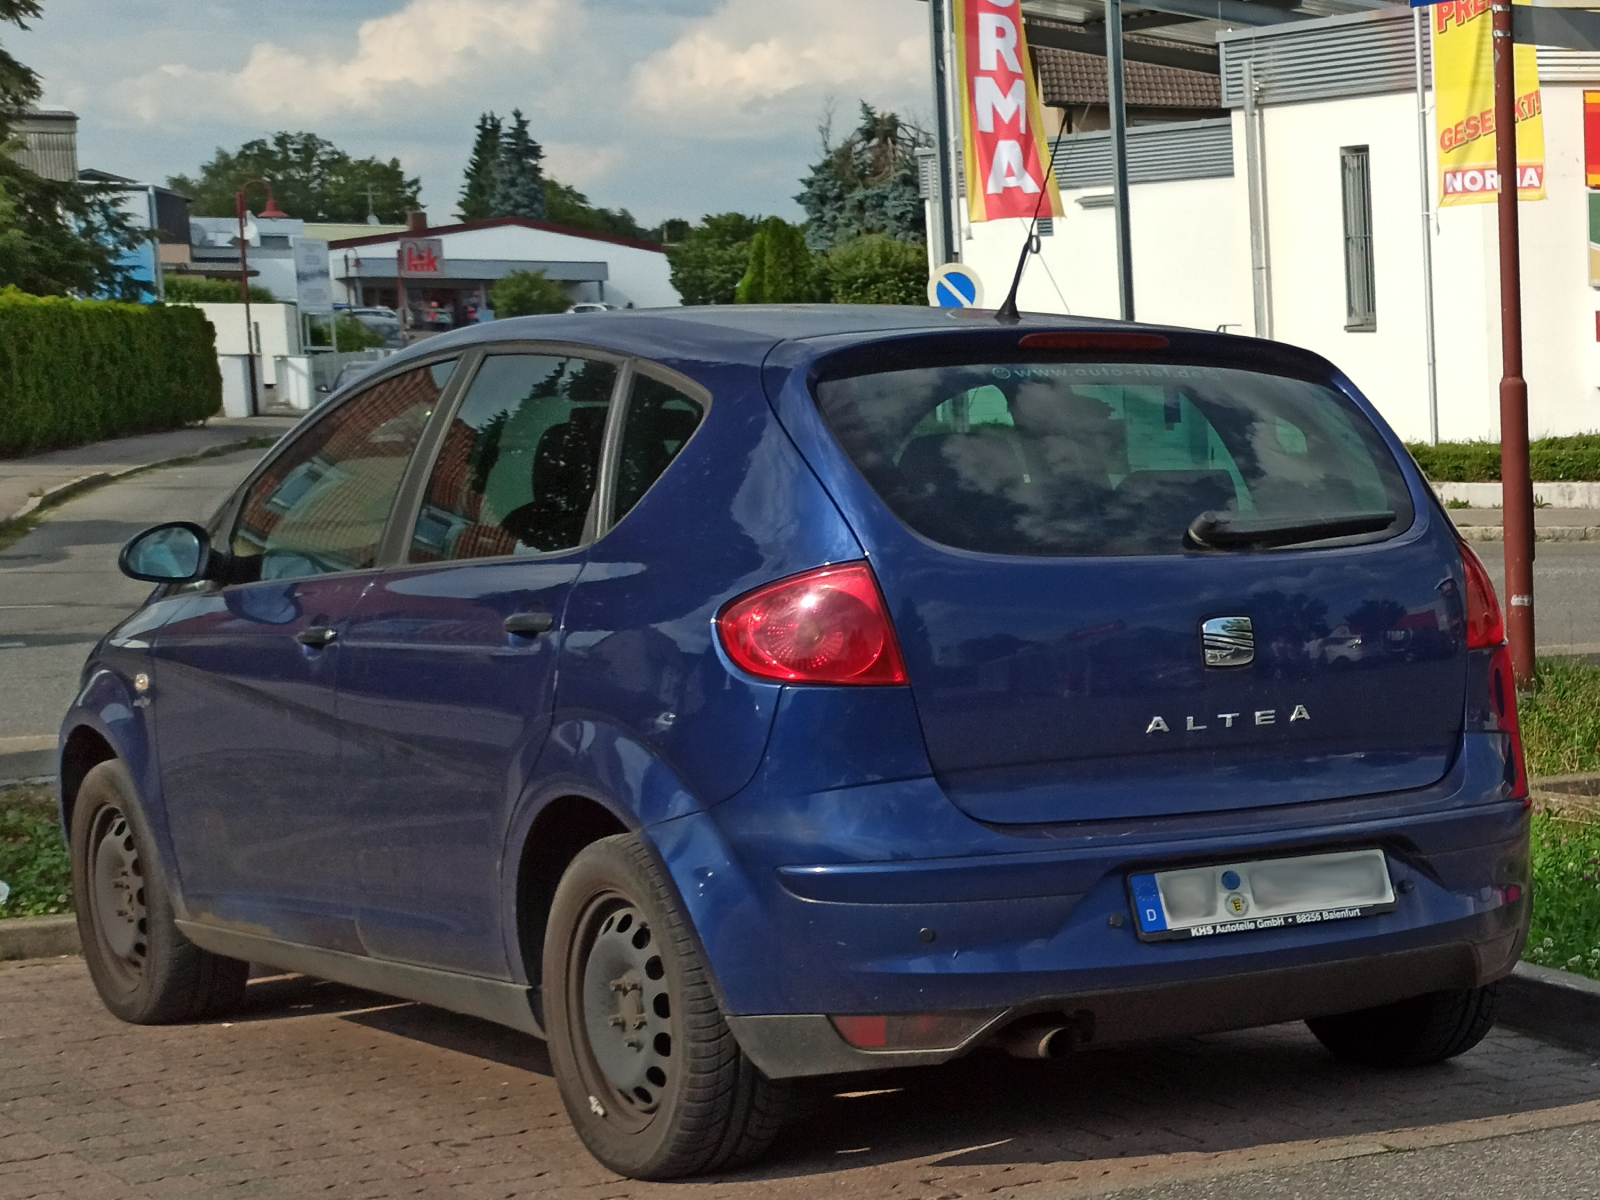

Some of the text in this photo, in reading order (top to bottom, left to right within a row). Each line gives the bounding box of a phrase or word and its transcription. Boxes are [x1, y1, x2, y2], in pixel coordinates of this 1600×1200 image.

[974, 0, 1040, 194] RMA
[1146, 704, 1311, 734] ALTEA
[1146, 909, 1157, 921] D
[1191, 925, 1214, 937] KHS
[1216, 921, 1256, 934] Autoteile
[1257, 917, 1285, 930] GmbH
